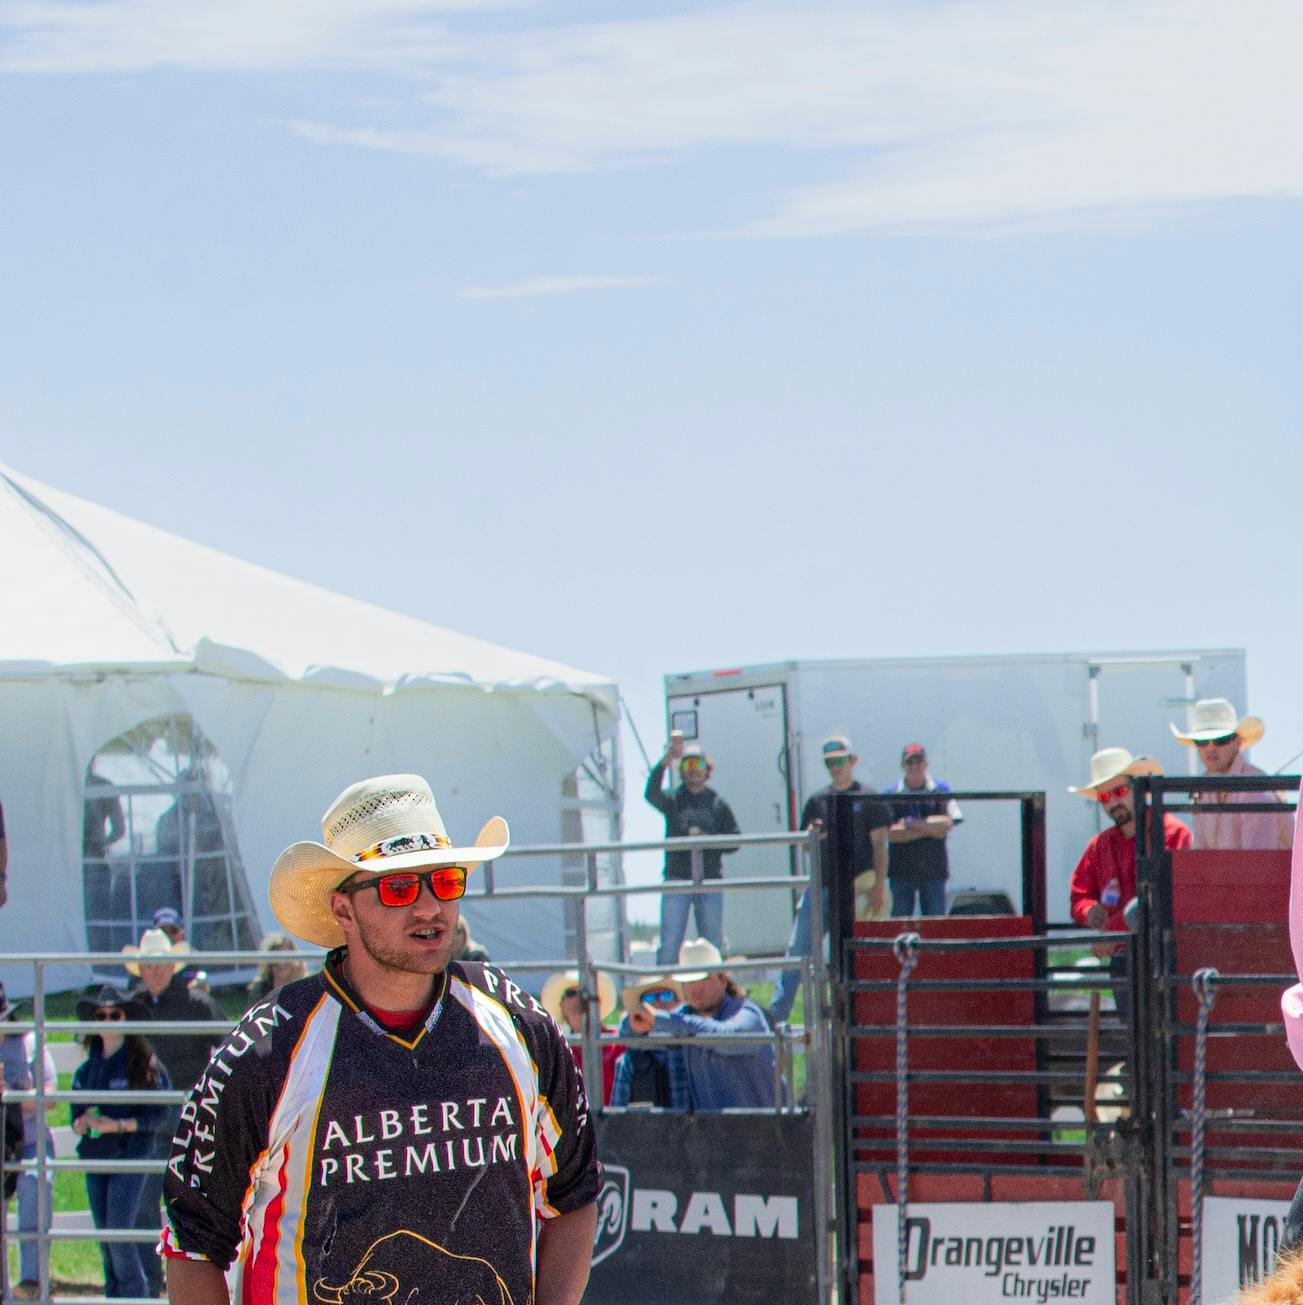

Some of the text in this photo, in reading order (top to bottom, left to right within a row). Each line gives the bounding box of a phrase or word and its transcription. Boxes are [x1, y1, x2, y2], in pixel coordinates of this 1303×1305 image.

[322, 1097, 514, 1151] ALBERTA
[321, 1134, 517, 1186] PREMIUM
[631, 1188, 798, 1239] RAM
[1002, 1272, 1092, 1304] Chrysler
